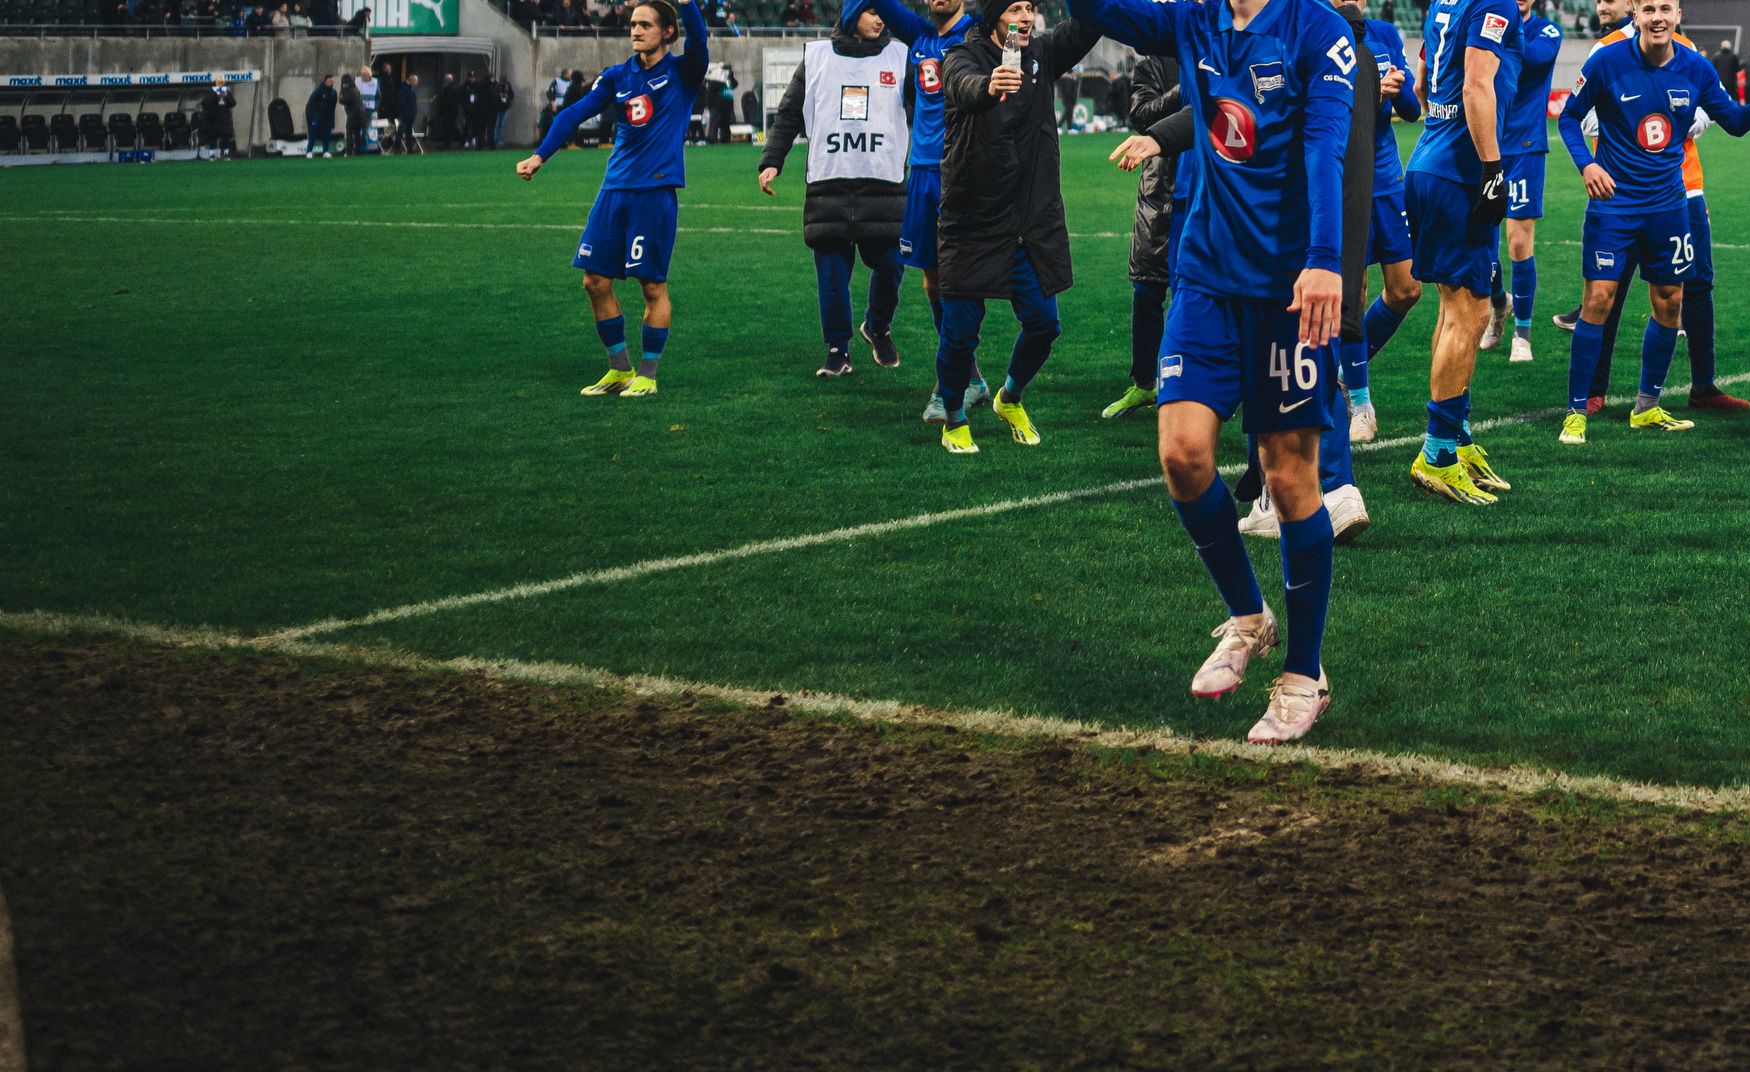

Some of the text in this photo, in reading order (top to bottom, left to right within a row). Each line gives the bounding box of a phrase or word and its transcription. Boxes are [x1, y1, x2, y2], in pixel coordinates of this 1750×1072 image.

[1431, 12, 1450, 93] 7
[9, 76, 42, 86] maxit
[55, 74, 88, 86] maxit
[101, 73, 131, 85] maxit
[139, 73, 170, 84] maxit
[182, 72, 212, 83] maxit
[224, 71, 253, 81] maxit
[922, 64, 939, 88] B
[628, 99, 647, 121] B
[826, 132, 885, 154] SMF
[1645, 120, 1665, 146] B
[1508, 179, 1529, 203] 41
[630, 235, 645, 261] 6
[1669, 232, 1694, 265] 26
[1269, 342, 1318, 392] 46
